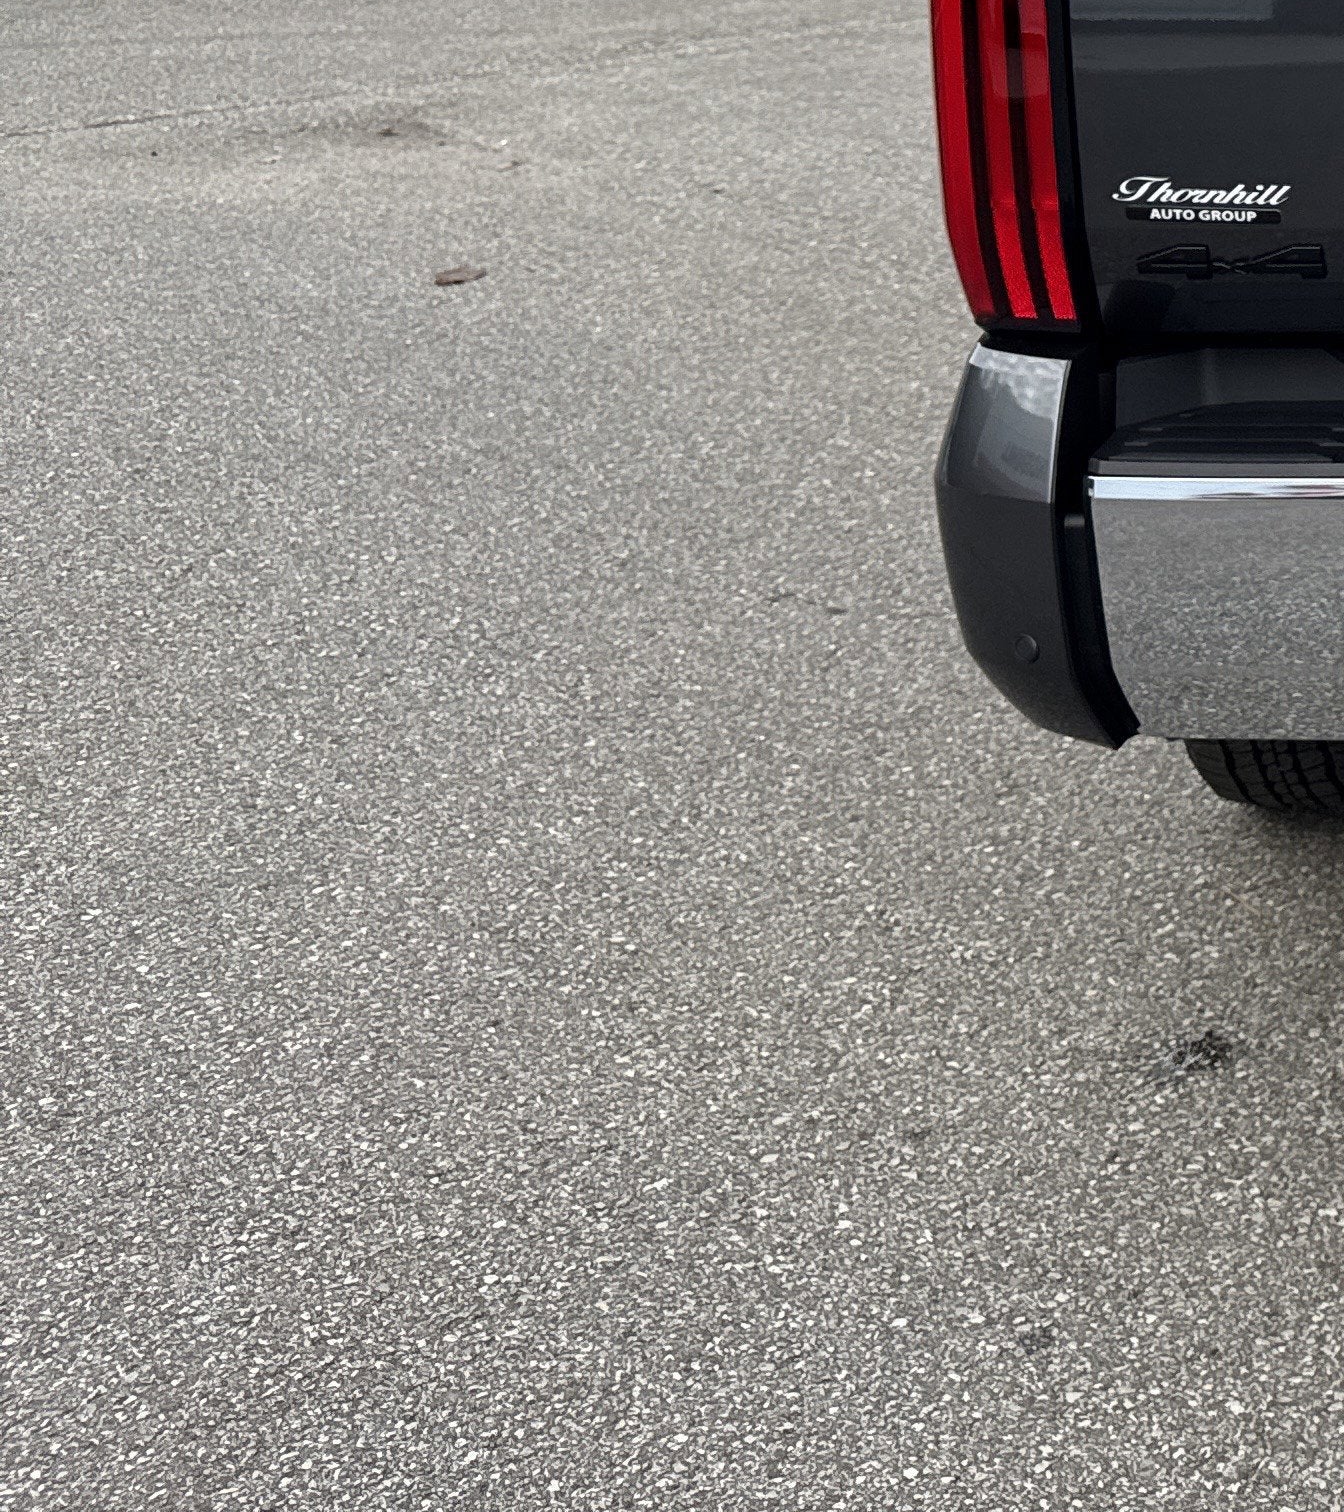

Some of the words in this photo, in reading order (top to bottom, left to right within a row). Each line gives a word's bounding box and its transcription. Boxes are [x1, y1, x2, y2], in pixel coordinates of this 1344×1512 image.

[1112, 176, 1292, 206] Thornhill
[1150, 208, 1196, 221] AUTO
[1198, 209, 1257, 223] GROUP
